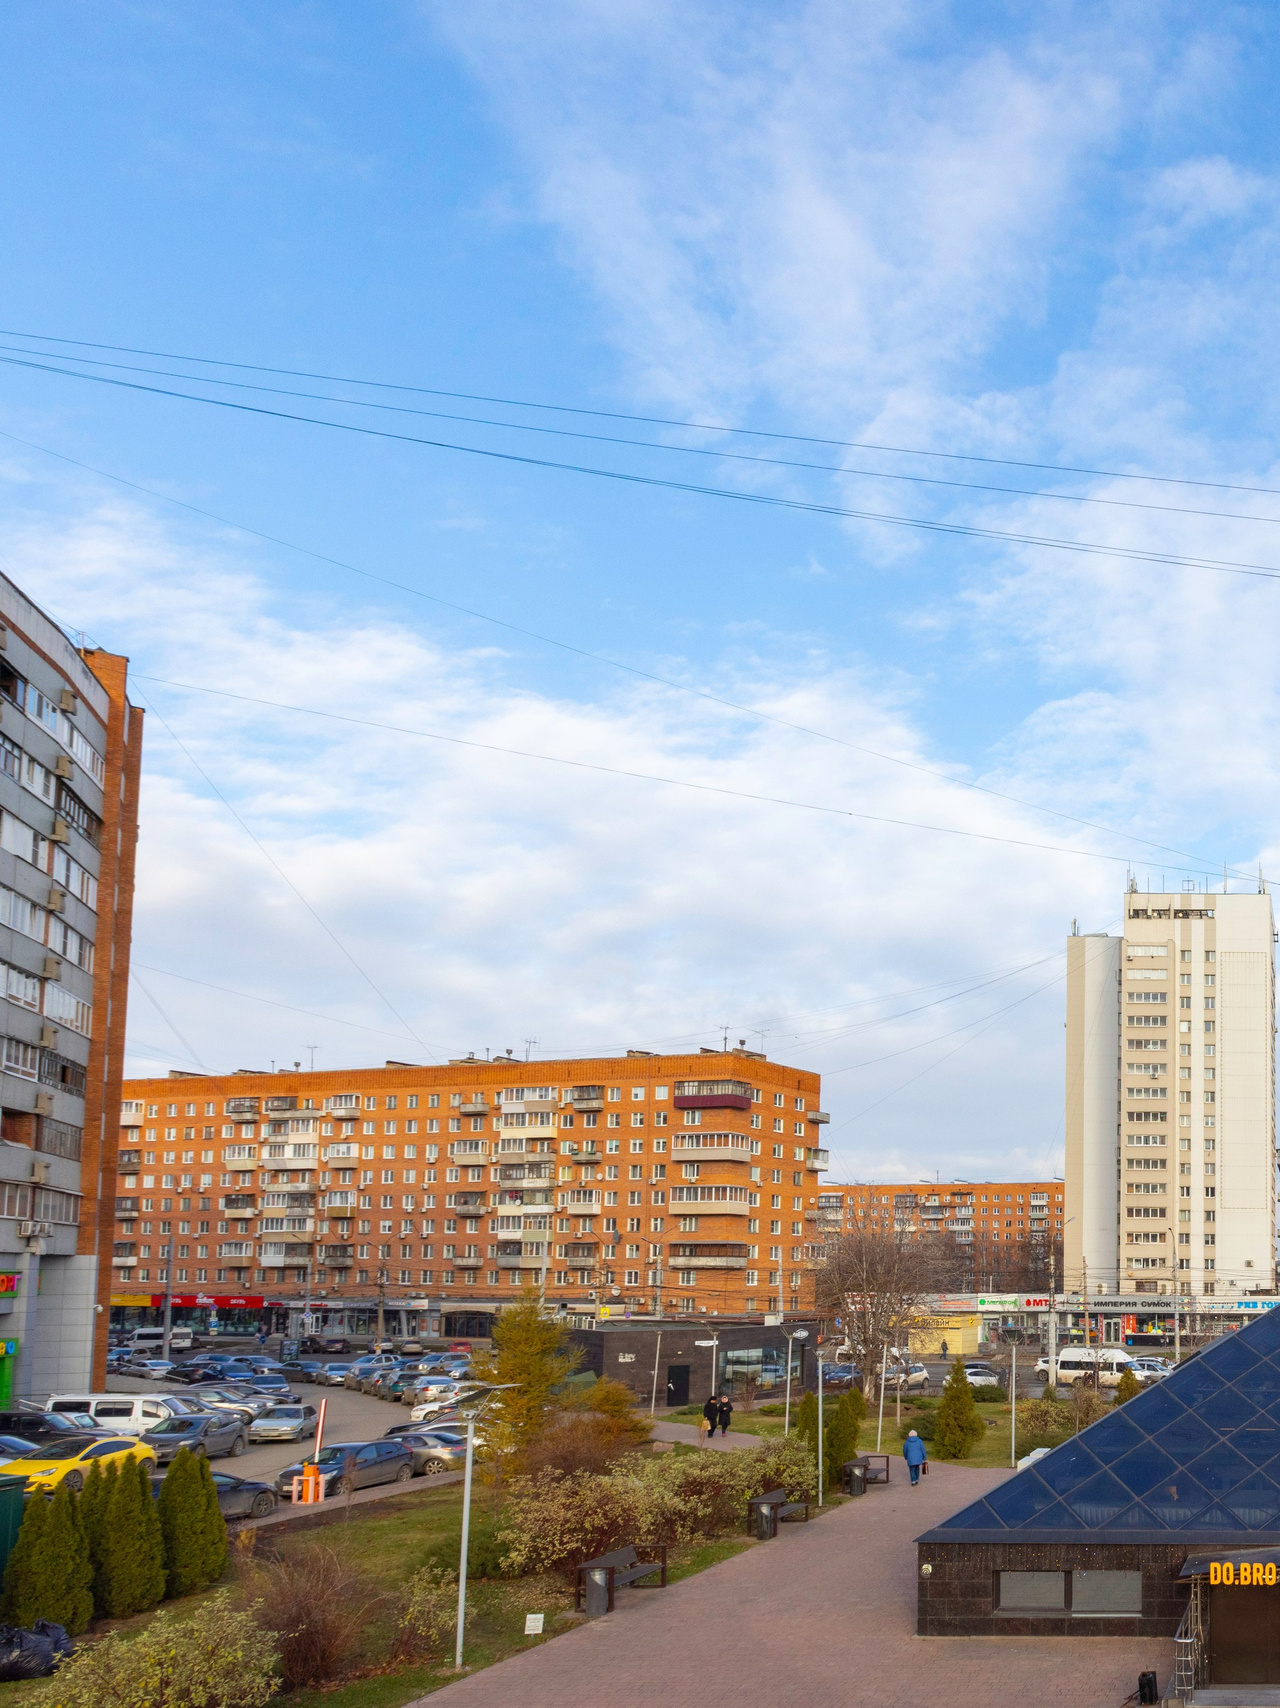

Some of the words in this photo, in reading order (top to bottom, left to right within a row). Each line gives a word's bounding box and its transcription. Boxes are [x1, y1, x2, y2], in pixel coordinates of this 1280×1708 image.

[1032, 1298, 1057, 1307] МТ
[1141, 1300, 1172, 1309] СУМОК
[1237, 1301, 1259, 1309] РИВ
[1209, 1562, 1277, 1585] DO.BRO
